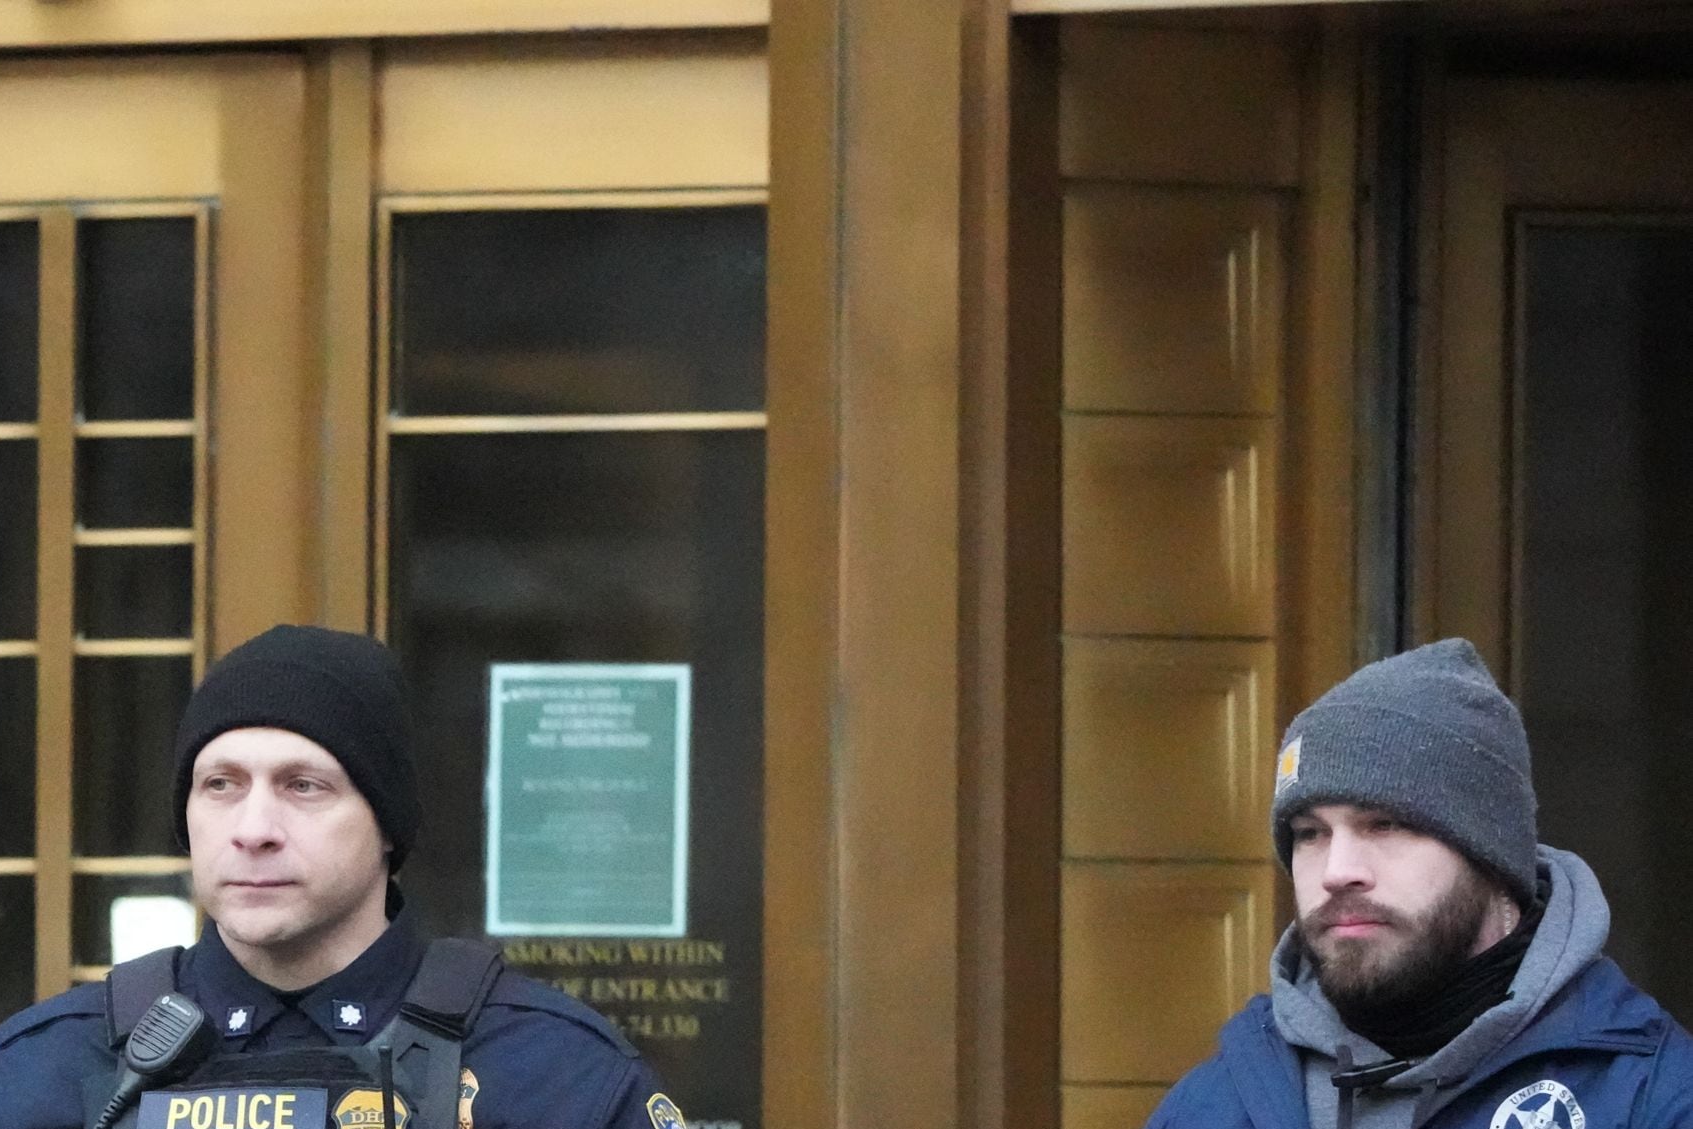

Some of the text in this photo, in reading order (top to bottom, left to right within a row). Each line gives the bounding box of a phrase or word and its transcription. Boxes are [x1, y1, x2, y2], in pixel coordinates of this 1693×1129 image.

[591, 977, 728, 1001] ENTRANCE
[1510, 1082, 1556, 1105] UNITED
[351, 1111, 385, 1123] DH
